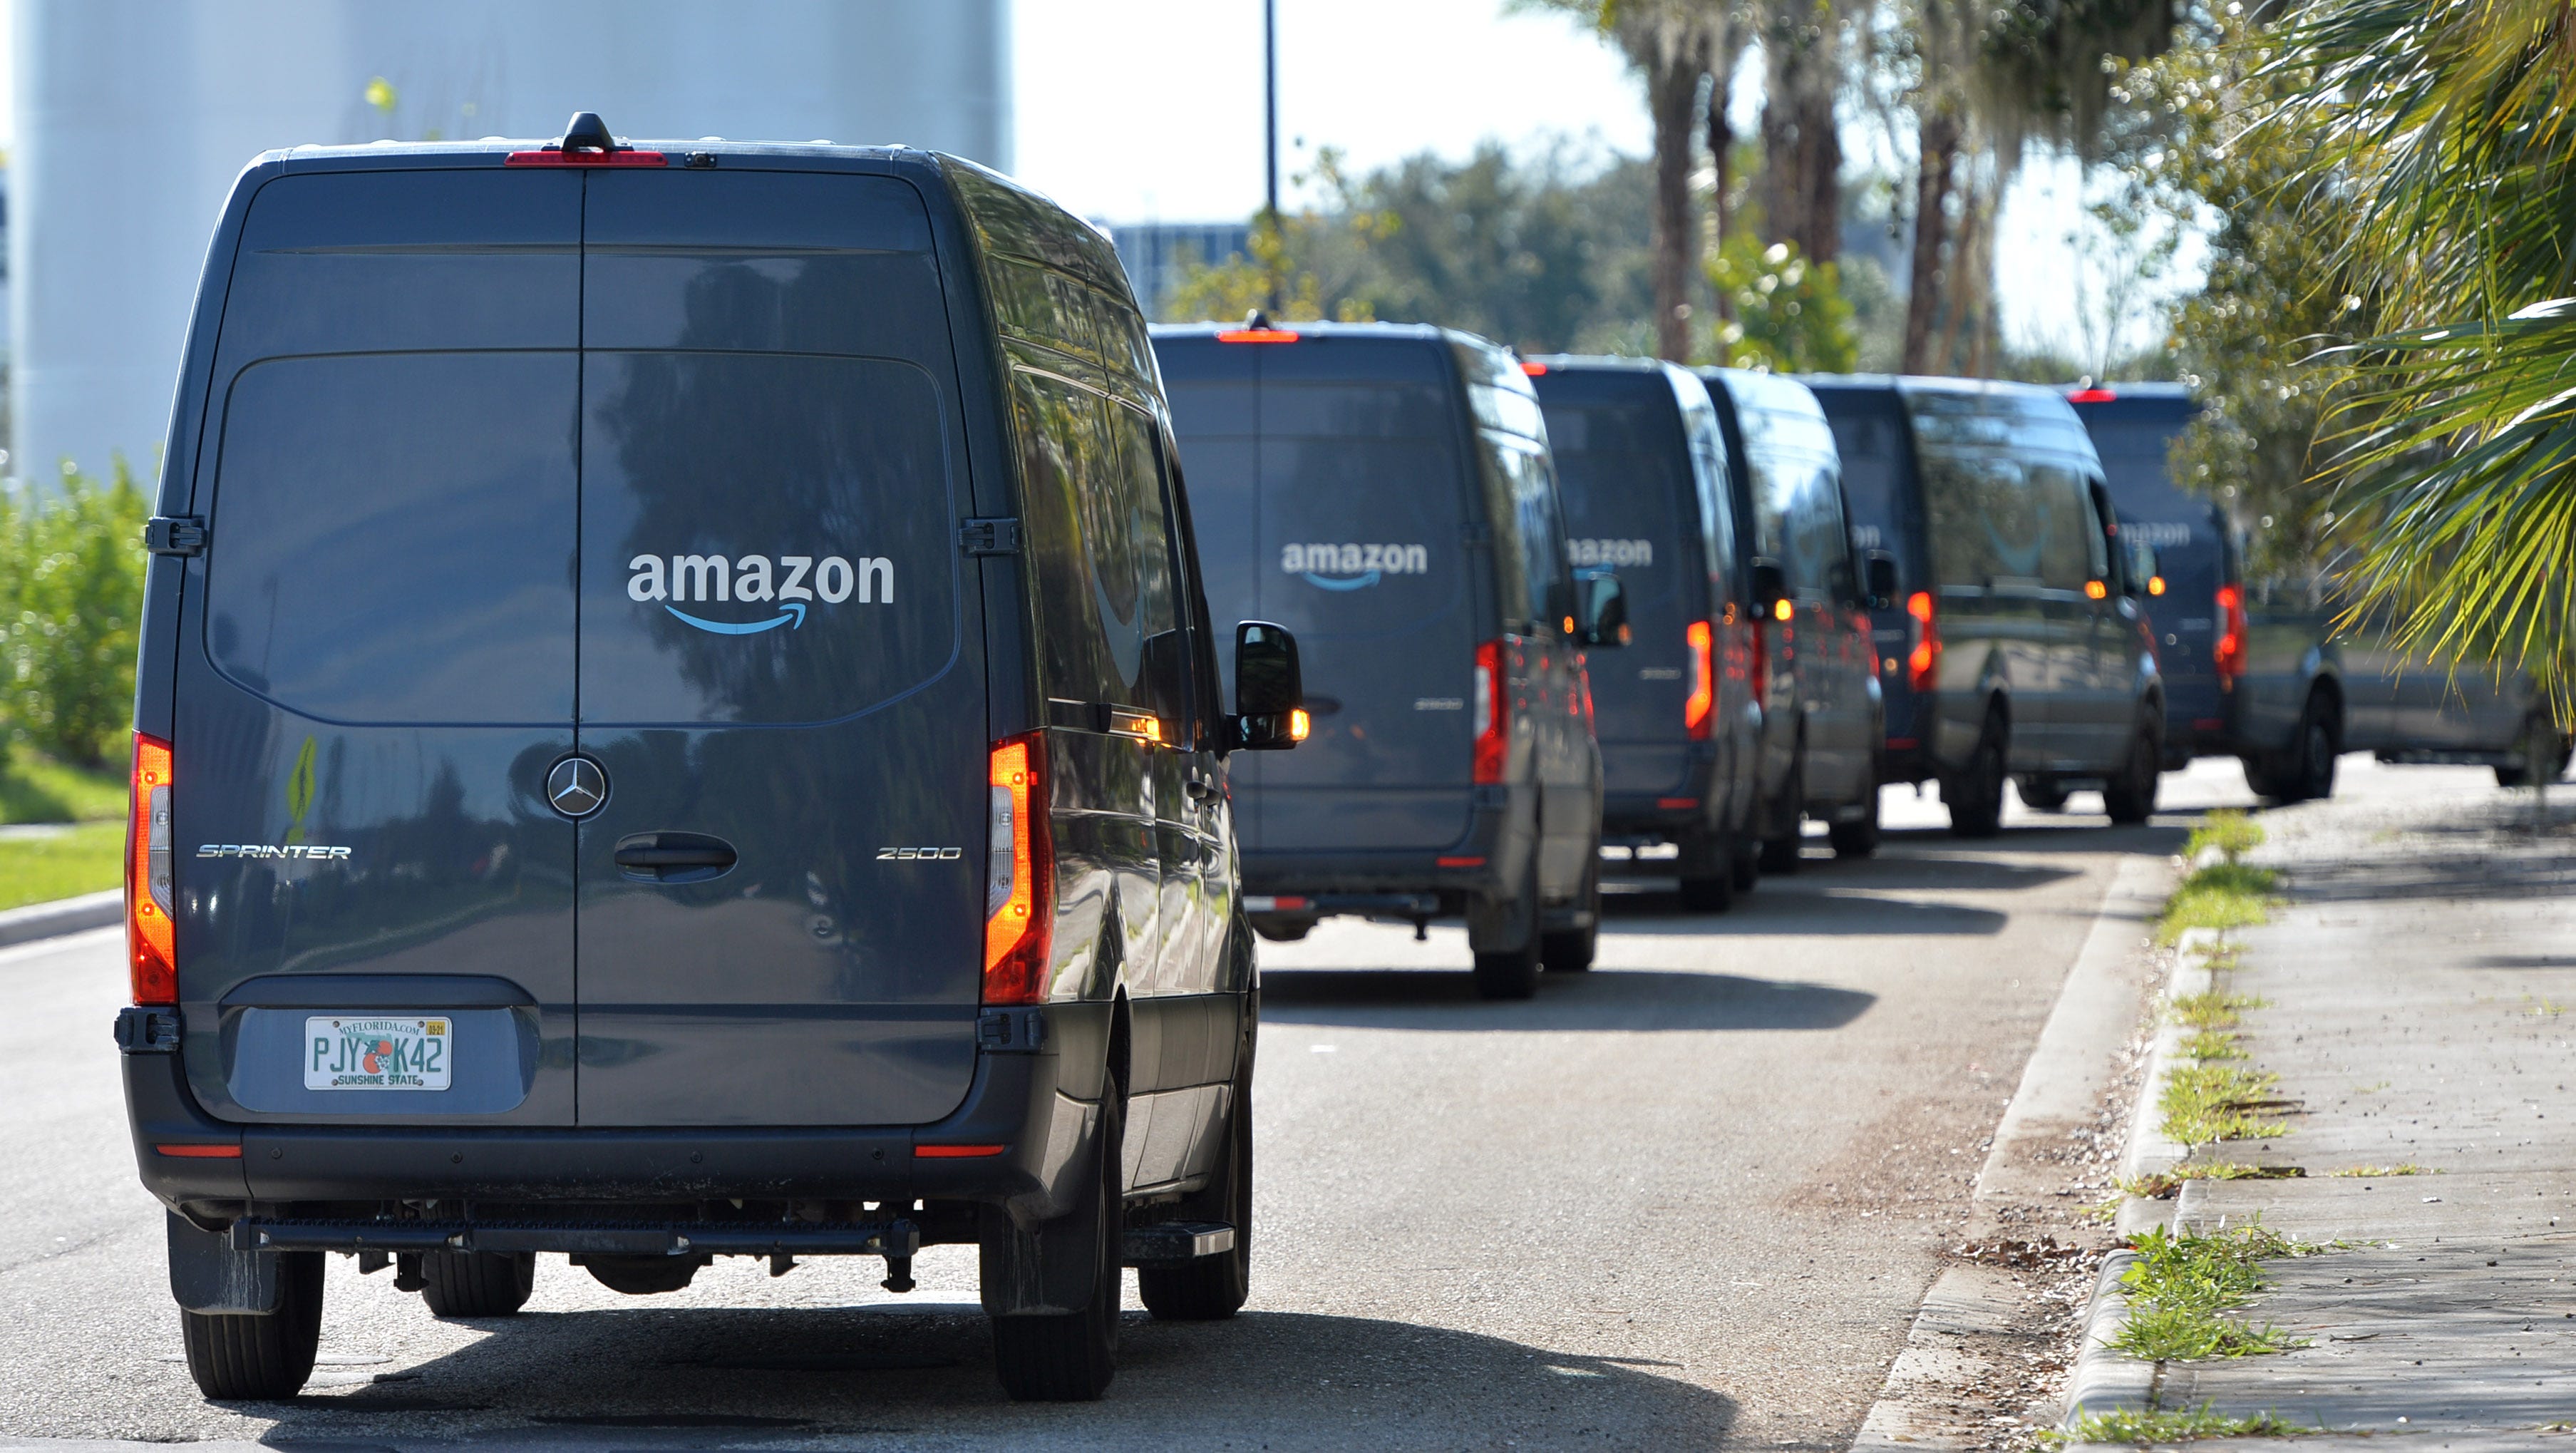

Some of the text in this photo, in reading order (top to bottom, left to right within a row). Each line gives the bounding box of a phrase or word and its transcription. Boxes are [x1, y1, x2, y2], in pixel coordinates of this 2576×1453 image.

[1282, 543, 1428, 573] amazon
[627, 554, 894, 604] amazon
[196, 844, 352, 860] SPRINTER
[876, 847, 962, 860] 2500
[338, 1021, 420, 1035] MYFLORIDA.COM
[313, 1037, 442, 1073] PJY K42
[338, 1075, 418, 1086] SUNSHINE STATE
